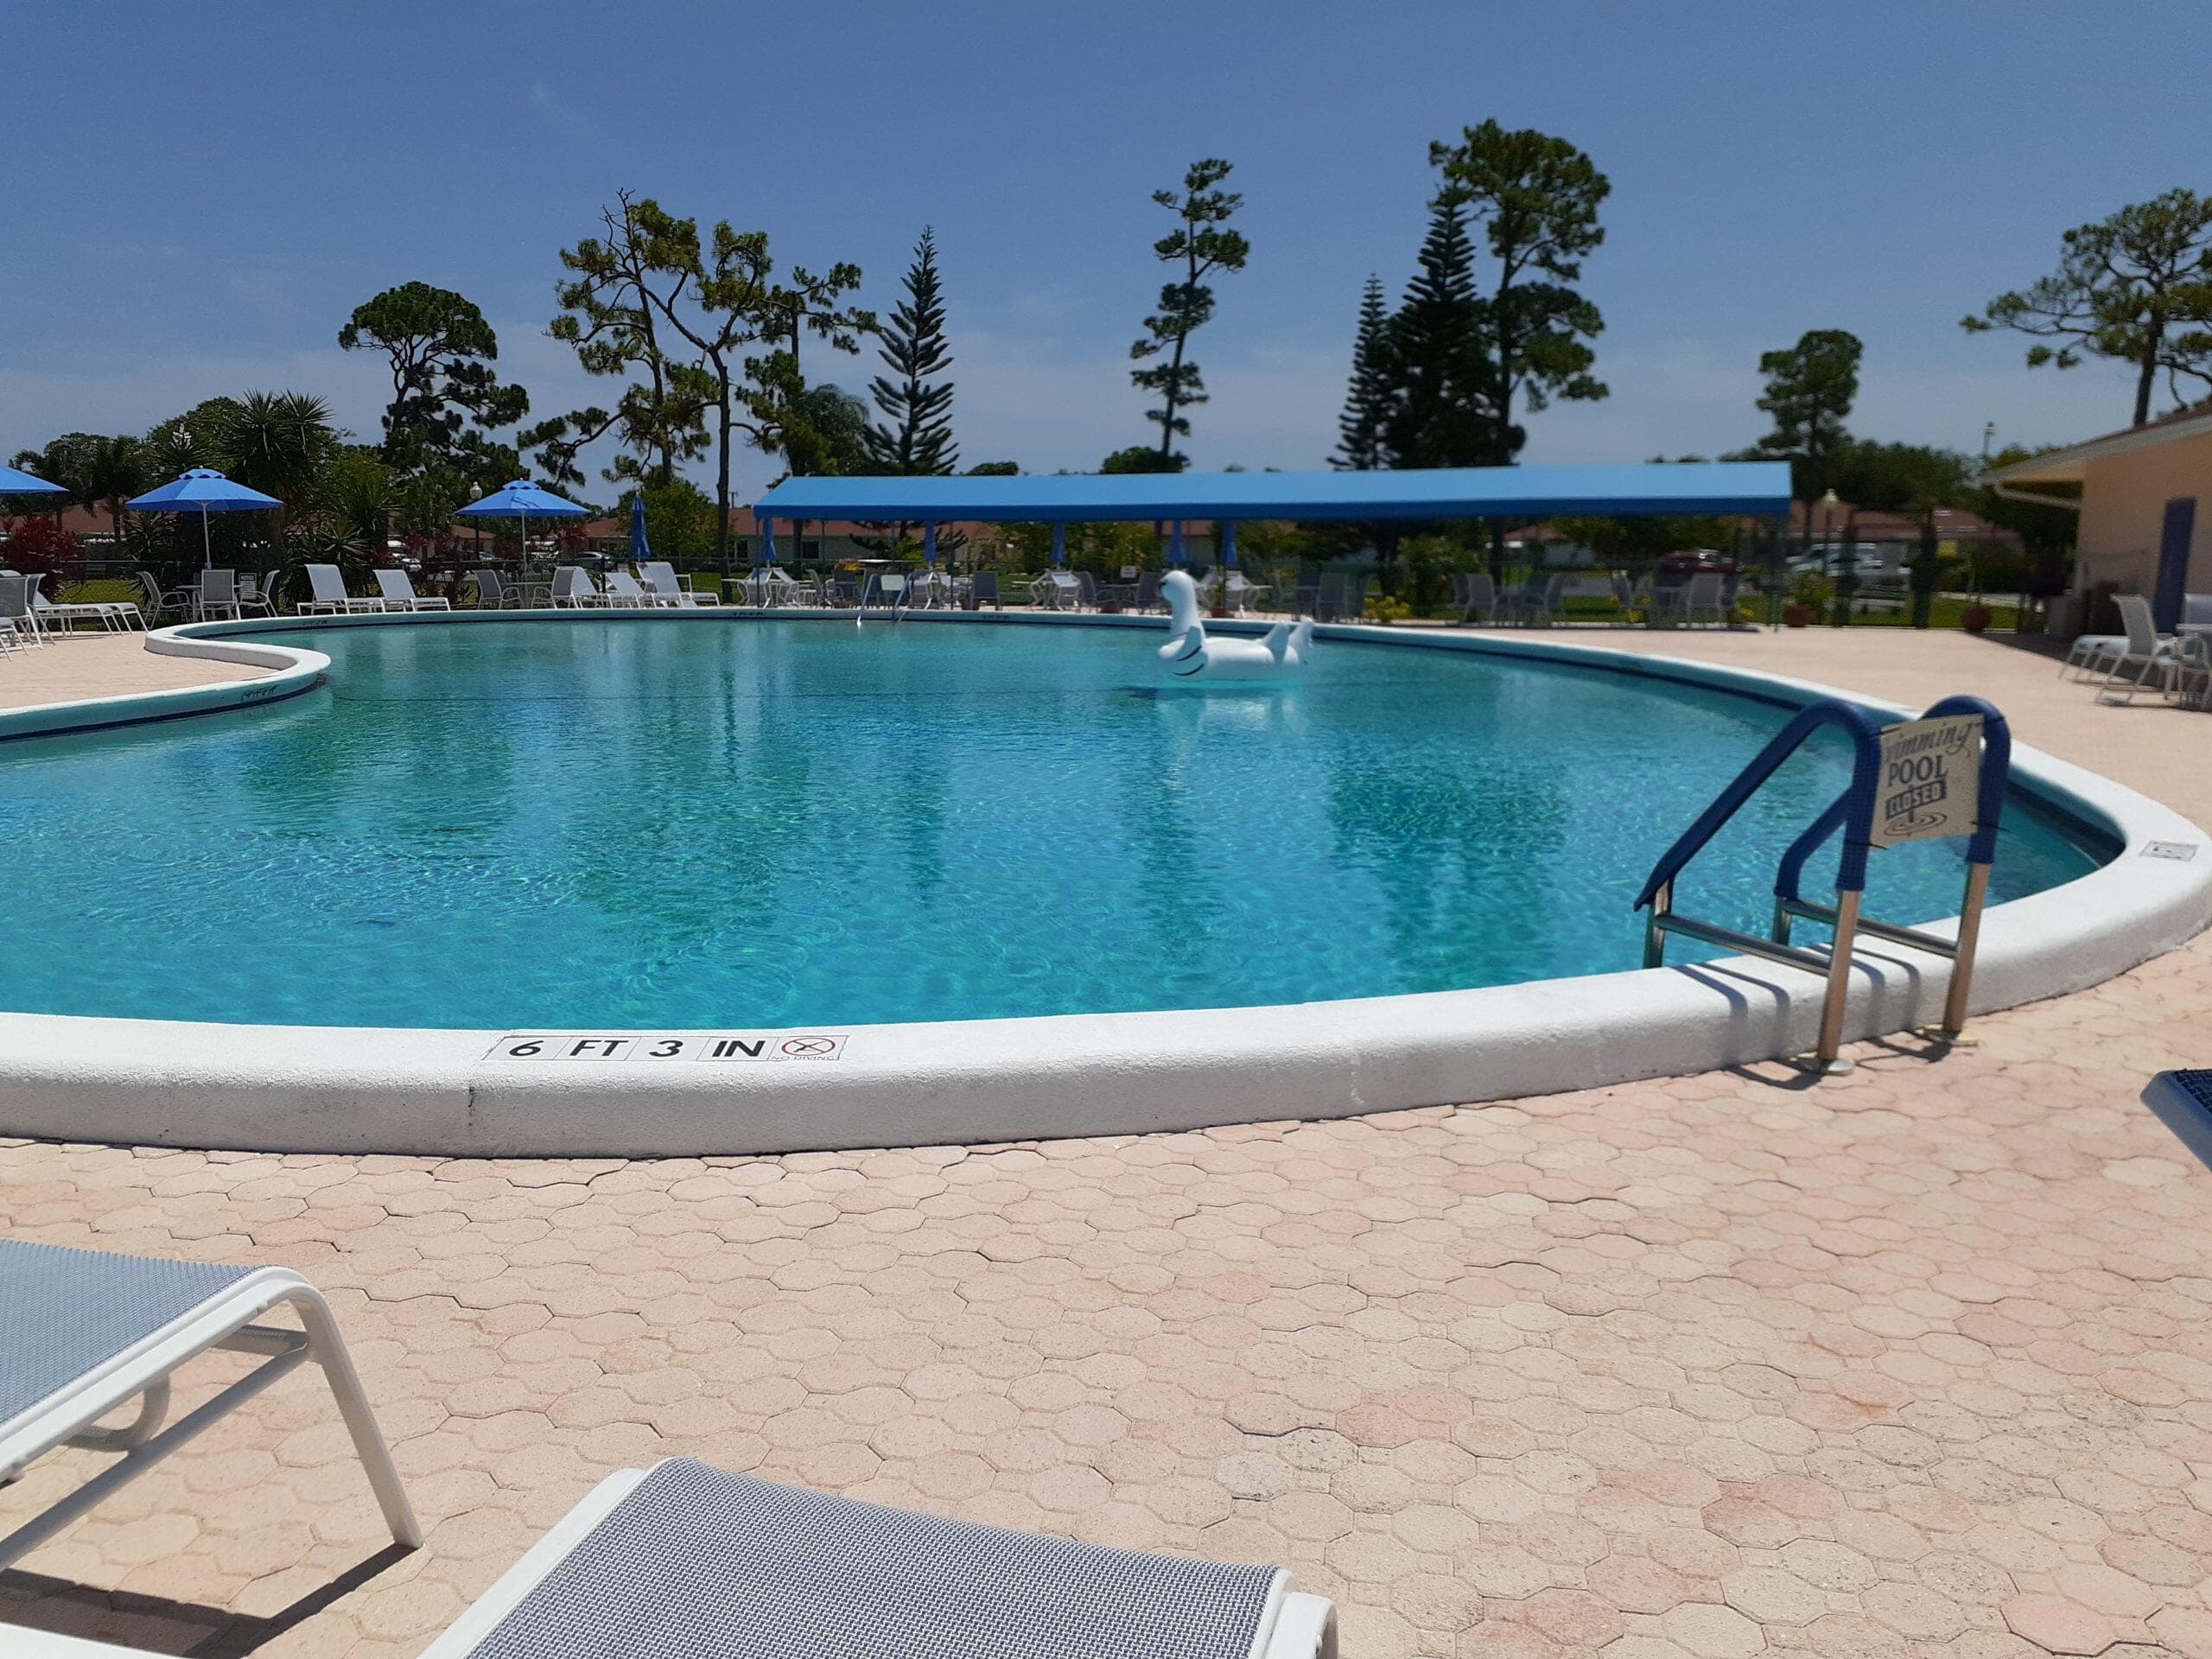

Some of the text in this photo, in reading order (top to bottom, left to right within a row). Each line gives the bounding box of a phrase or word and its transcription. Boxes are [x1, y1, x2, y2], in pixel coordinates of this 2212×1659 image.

[1888, 755, 1948, 786] POOL
[1890, 784, 1941, 815] CLOSED
[509, 1039, 766, 1057] 6 FT 3 IN
